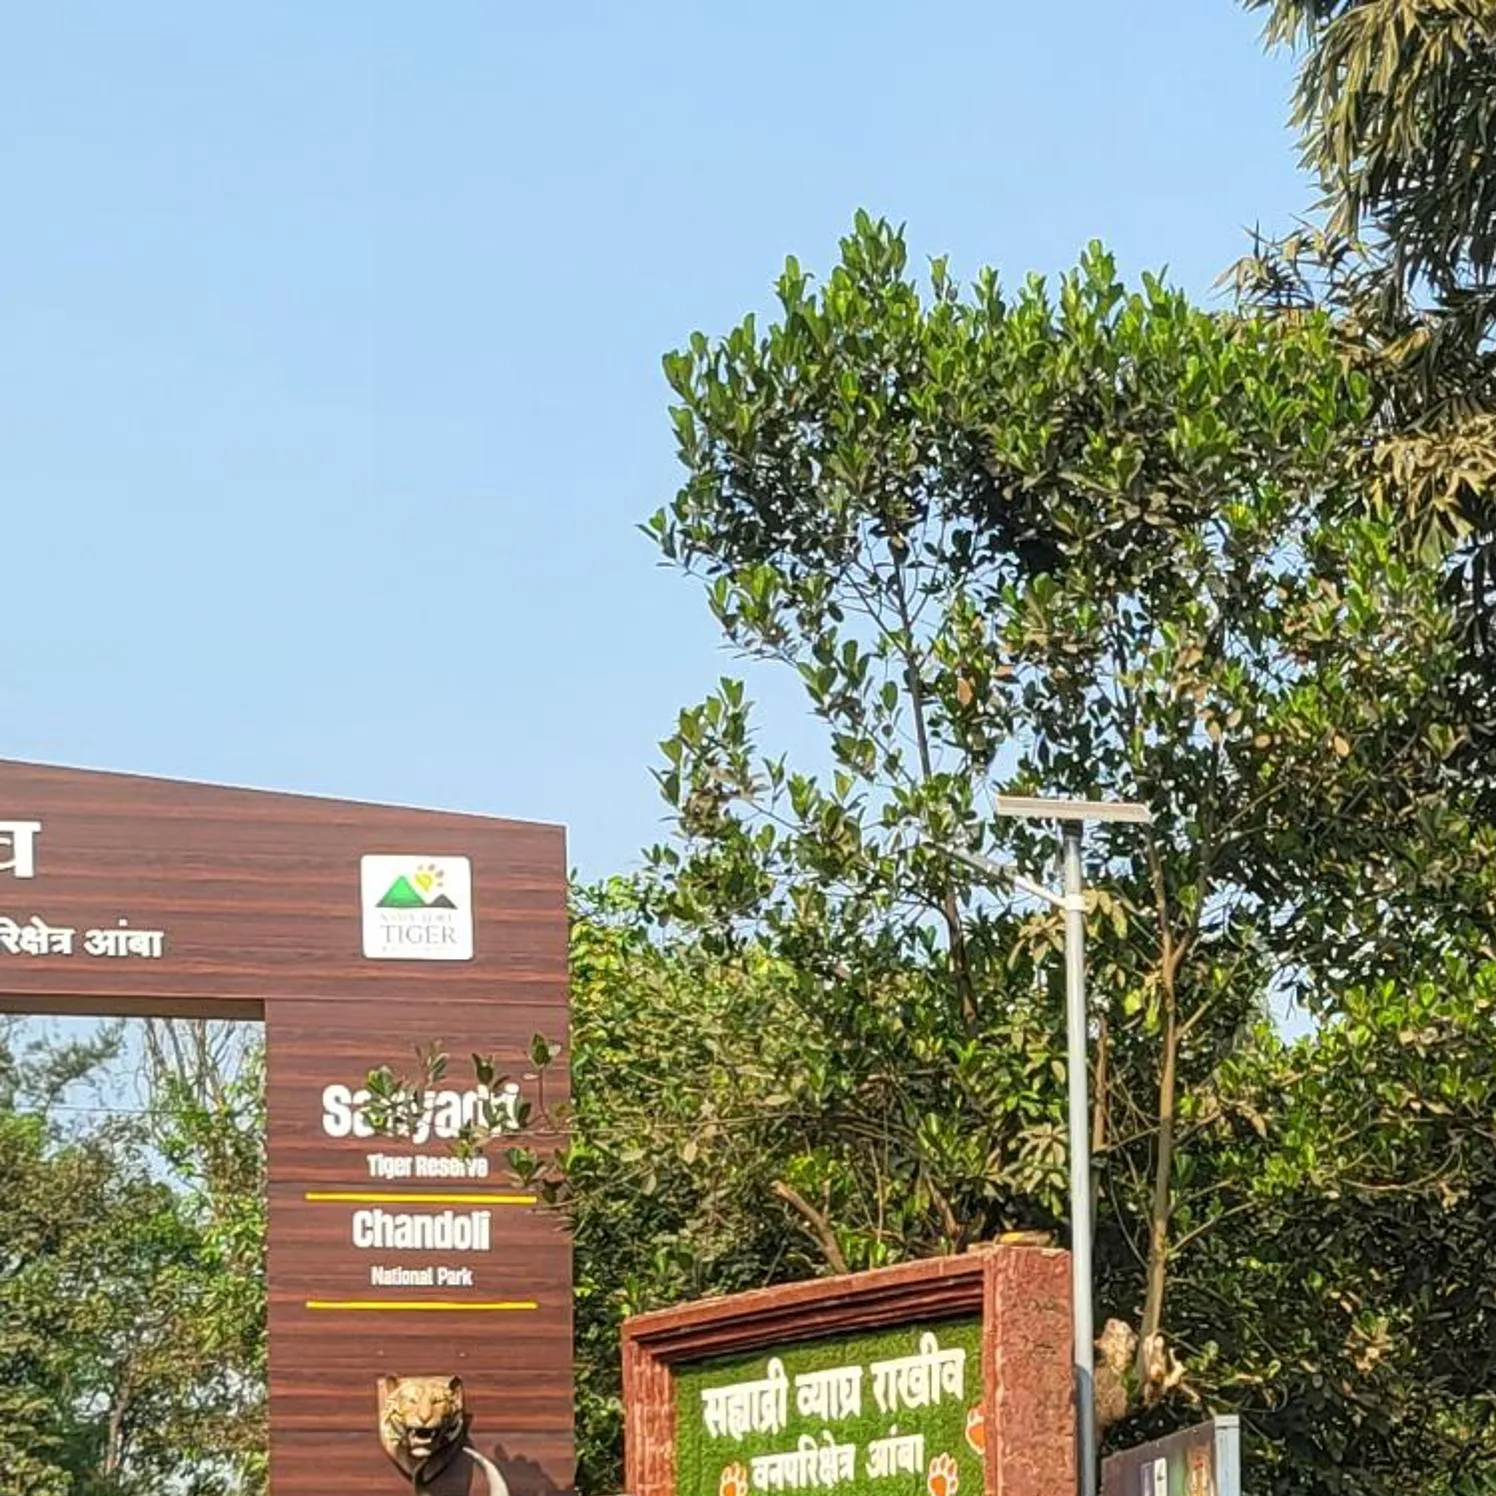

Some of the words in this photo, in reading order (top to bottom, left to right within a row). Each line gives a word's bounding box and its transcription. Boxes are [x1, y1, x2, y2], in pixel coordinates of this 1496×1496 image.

[84, 919, 164, 957] आंबा
[380, 925, 459, 944] TIGER
[367, 1154, 413, 1179] Tiger
[415, 1155, 489, 1178] Reserve
[353, 1209, 492, 1251] Chandoli
[370, 1266, 433, 1286] National
[437, 1267, 473, 1286] Park
[795, 1366, 863, 1421] व्याघ्र
[870, 1332, 966, 1414] राखीव
[751, 1430, 856, 1491] वनपरिक्षेत्र
[866, 1424, 925, 1479] आंबा
